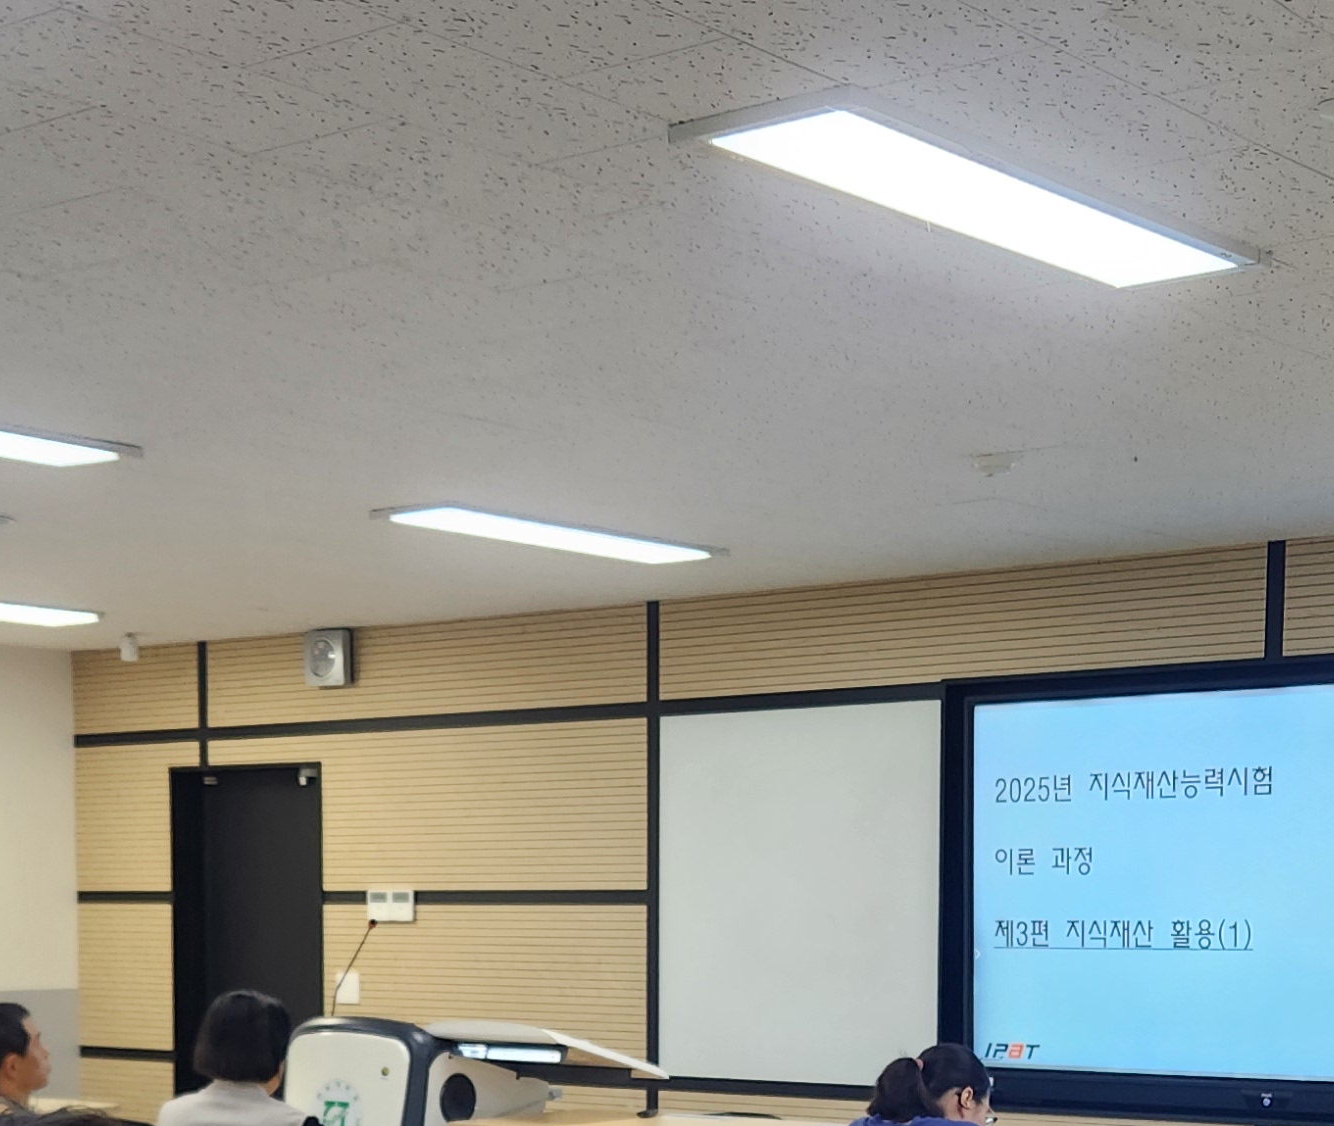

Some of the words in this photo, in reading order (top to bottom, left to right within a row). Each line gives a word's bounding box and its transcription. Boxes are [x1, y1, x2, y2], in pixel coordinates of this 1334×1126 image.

[995, 775, 1072, 803] 2025년
[1089, 766, 1273, 801] 지식재산능력시험
[995, 848, 1036, 875] 이론
[1051, 847, 1093, 875] 과정
[995, 919, 1049, 948] 제3편
[1066, 919, 1154, 949] 지식재산
[1171, 918, 1252, 950] 활용(1)
